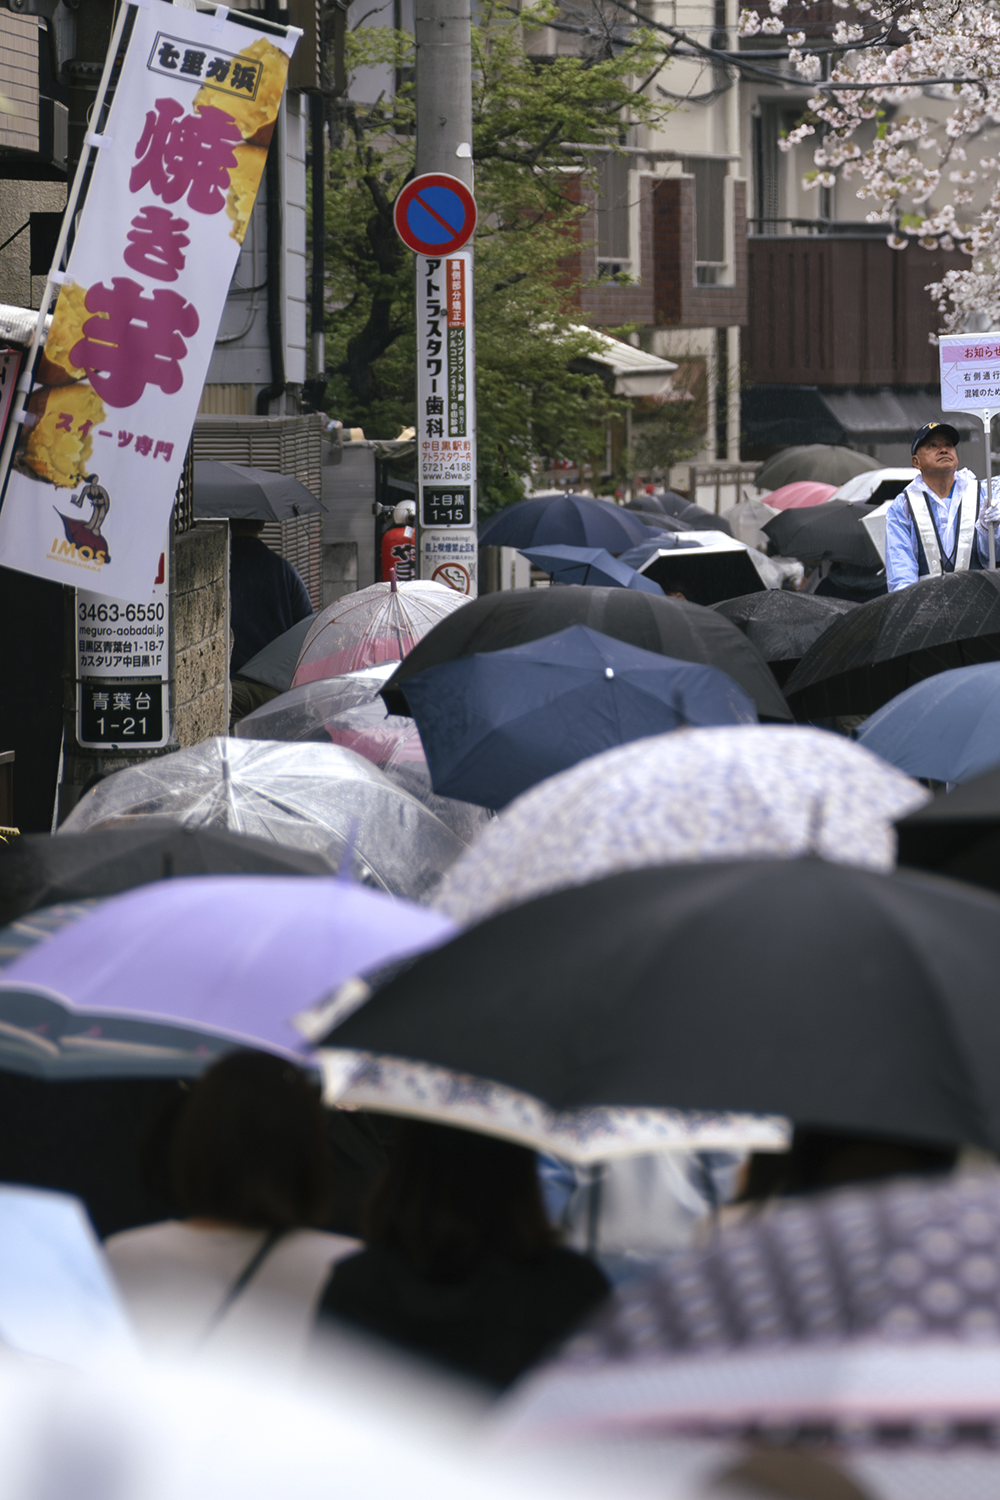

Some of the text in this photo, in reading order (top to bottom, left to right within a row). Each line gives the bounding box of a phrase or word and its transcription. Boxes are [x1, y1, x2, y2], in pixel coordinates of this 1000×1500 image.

[69, 97, 243, 408] 焼き芋
[425, 259, 444, 438] アトラスタワー歯科
[963, 370, 1000, 382] 右側通行
[55, 412, 174, 462] スイーツ専門
[422, 440, 471, 451] 中目黒駅前
[422, 452, 471, 462] アトラスタワー内
[430, 494, 465, 506] 上目黒
[432, 509, 464, 521] 1-15
[50, 537, 106, 566] IMOS
[79, 602, 165, 622] 3463-6550
[79, 624, 164, 638] meguro-aobadai.jp
[79, 639, 165, 653] 目黒区青葉台1-18-7
[92, 691, 151, 711] 青葉台
[96, 716, 149, 735] 1-21
